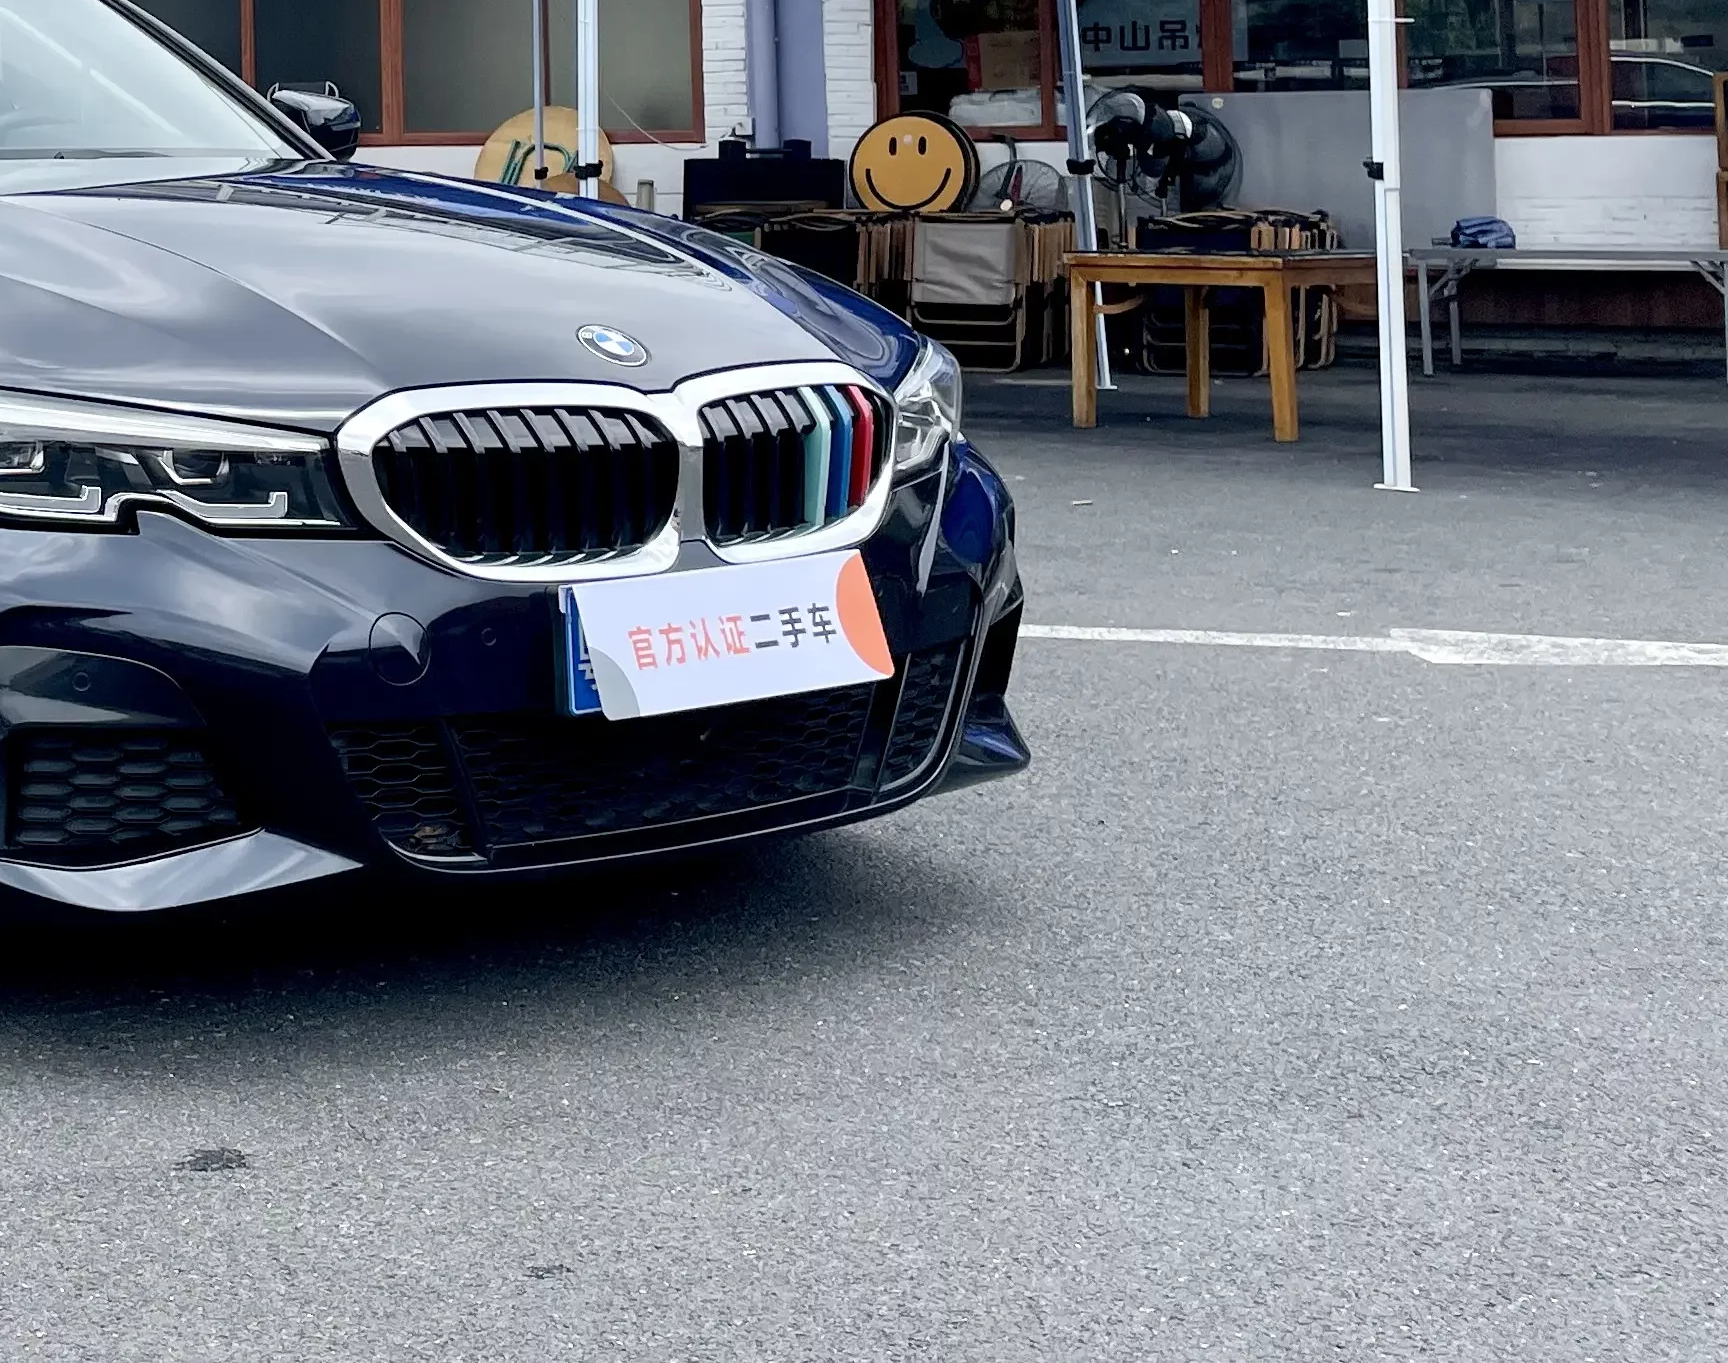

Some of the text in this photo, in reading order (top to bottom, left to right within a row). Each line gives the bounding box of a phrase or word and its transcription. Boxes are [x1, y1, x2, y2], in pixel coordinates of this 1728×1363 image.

[1081, 20, 1202, 52] 中山吊
[627, 603, 837, 671] 官方认证二手车
